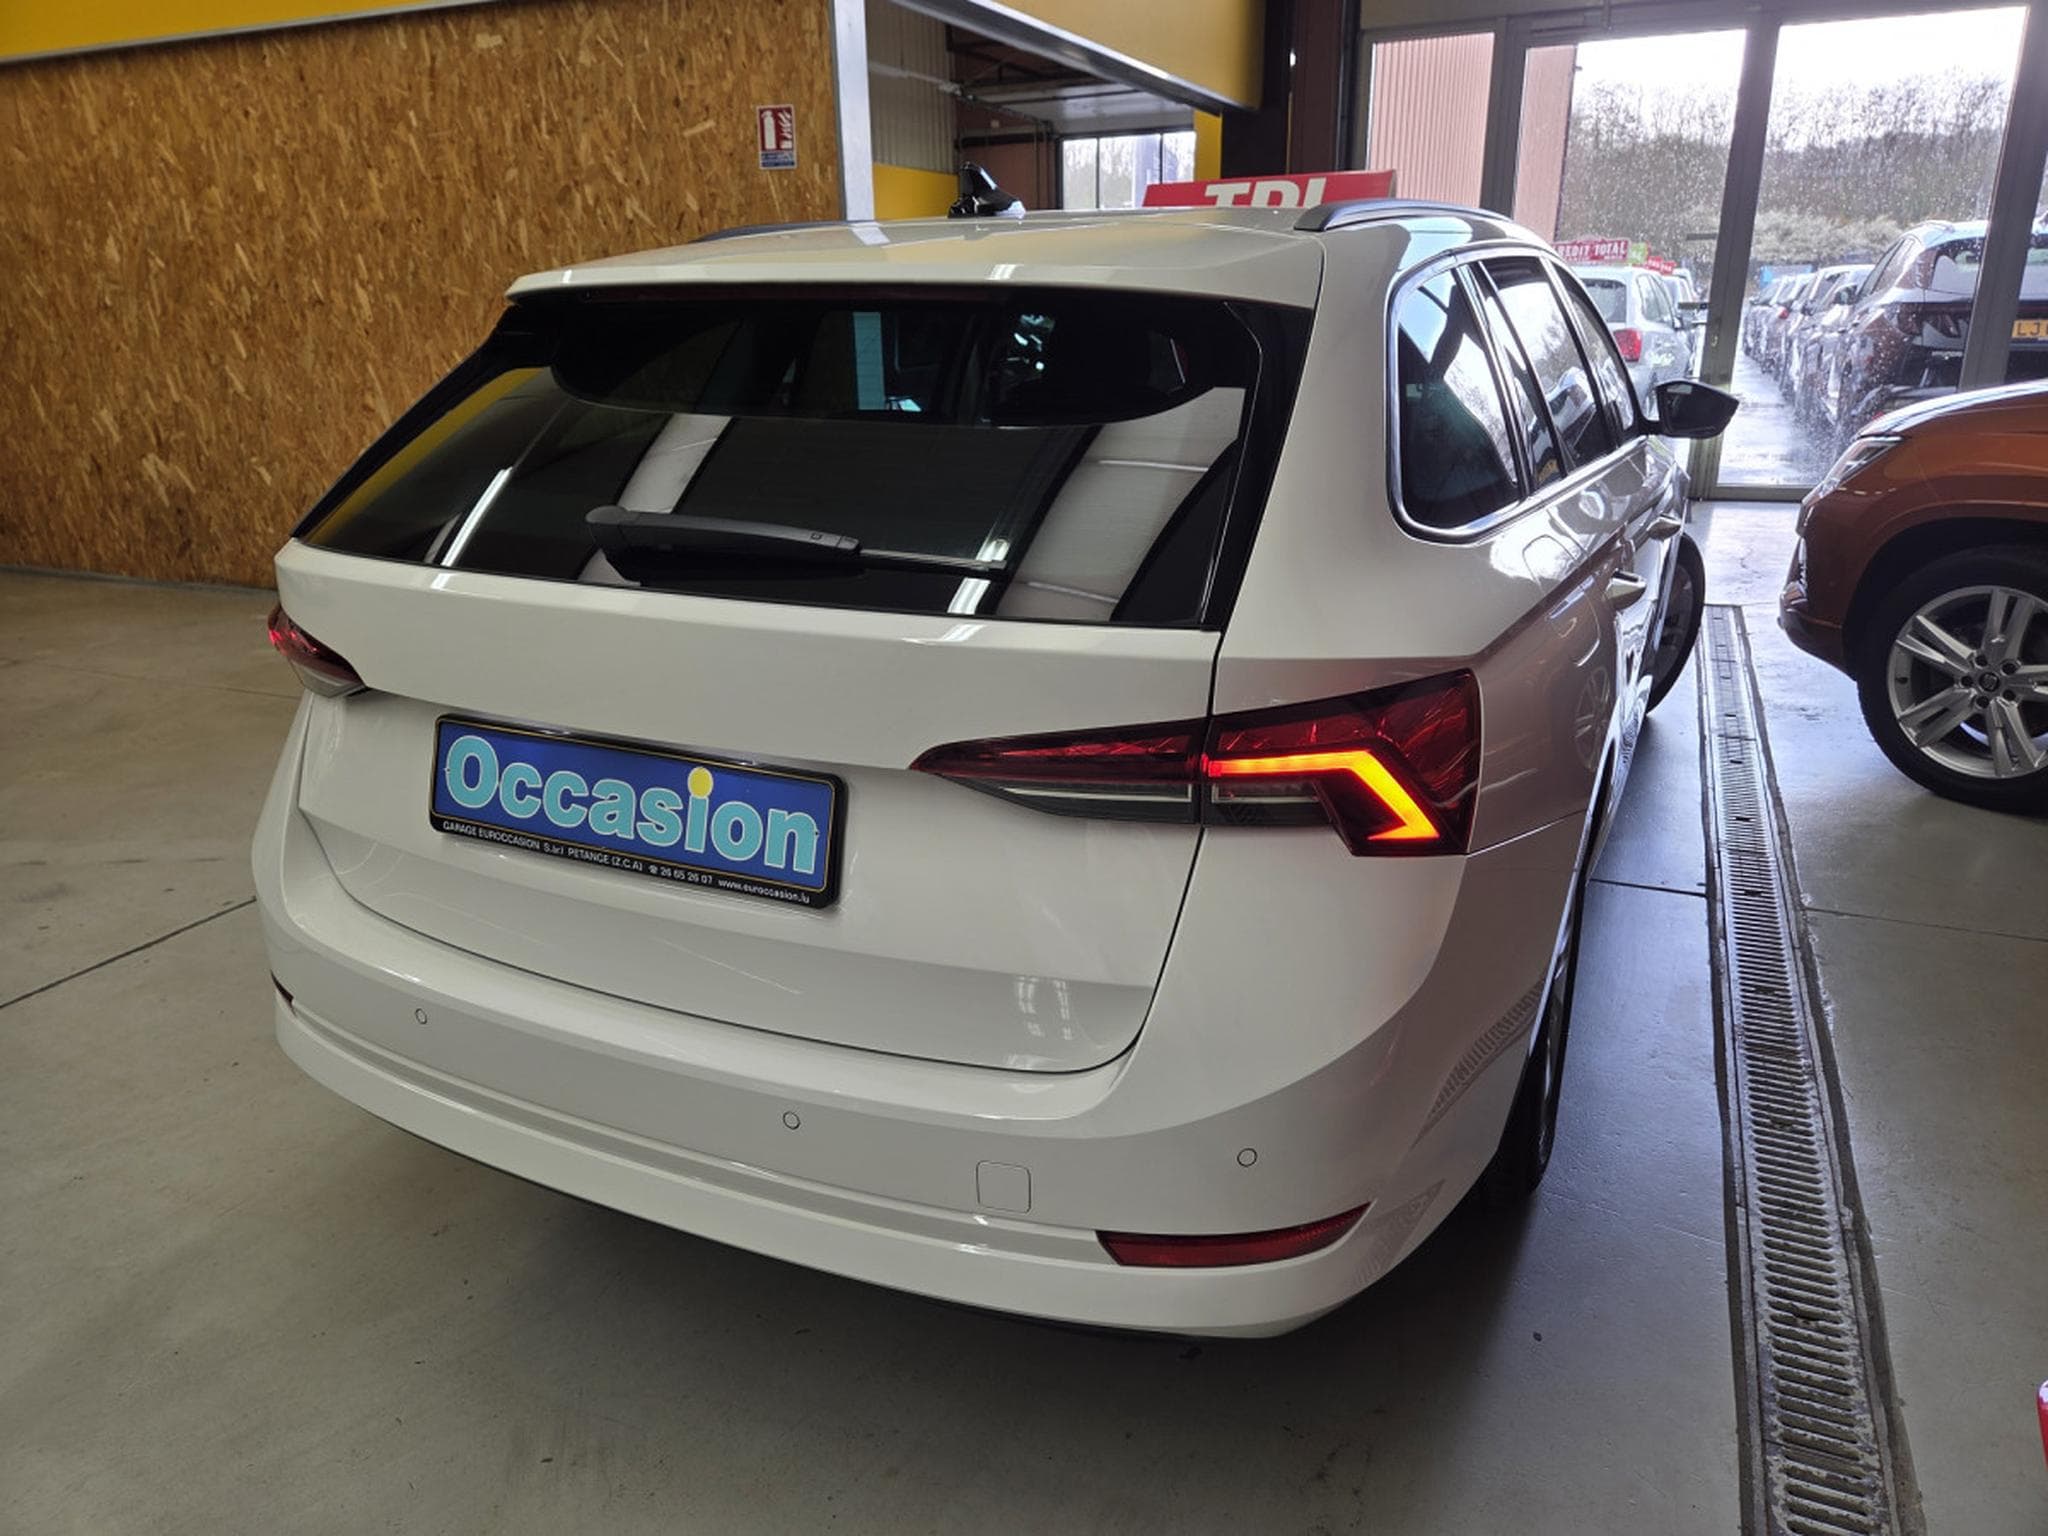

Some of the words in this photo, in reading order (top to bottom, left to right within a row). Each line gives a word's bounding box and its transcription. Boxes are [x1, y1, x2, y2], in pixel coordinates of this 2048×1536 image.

[1553, 244, 1591, 257] REDIT
[1594, 241, 1626, 256] TOTAL
[2017, 322, 2048, 336] LJ
[446, 735, 818, 875] Occasion
[442, 820, 477, 837] GARAGE
[479, 827, 540, 850] EUROCCASION
[718, 879, 811, 904] www.euroccasion.lu
